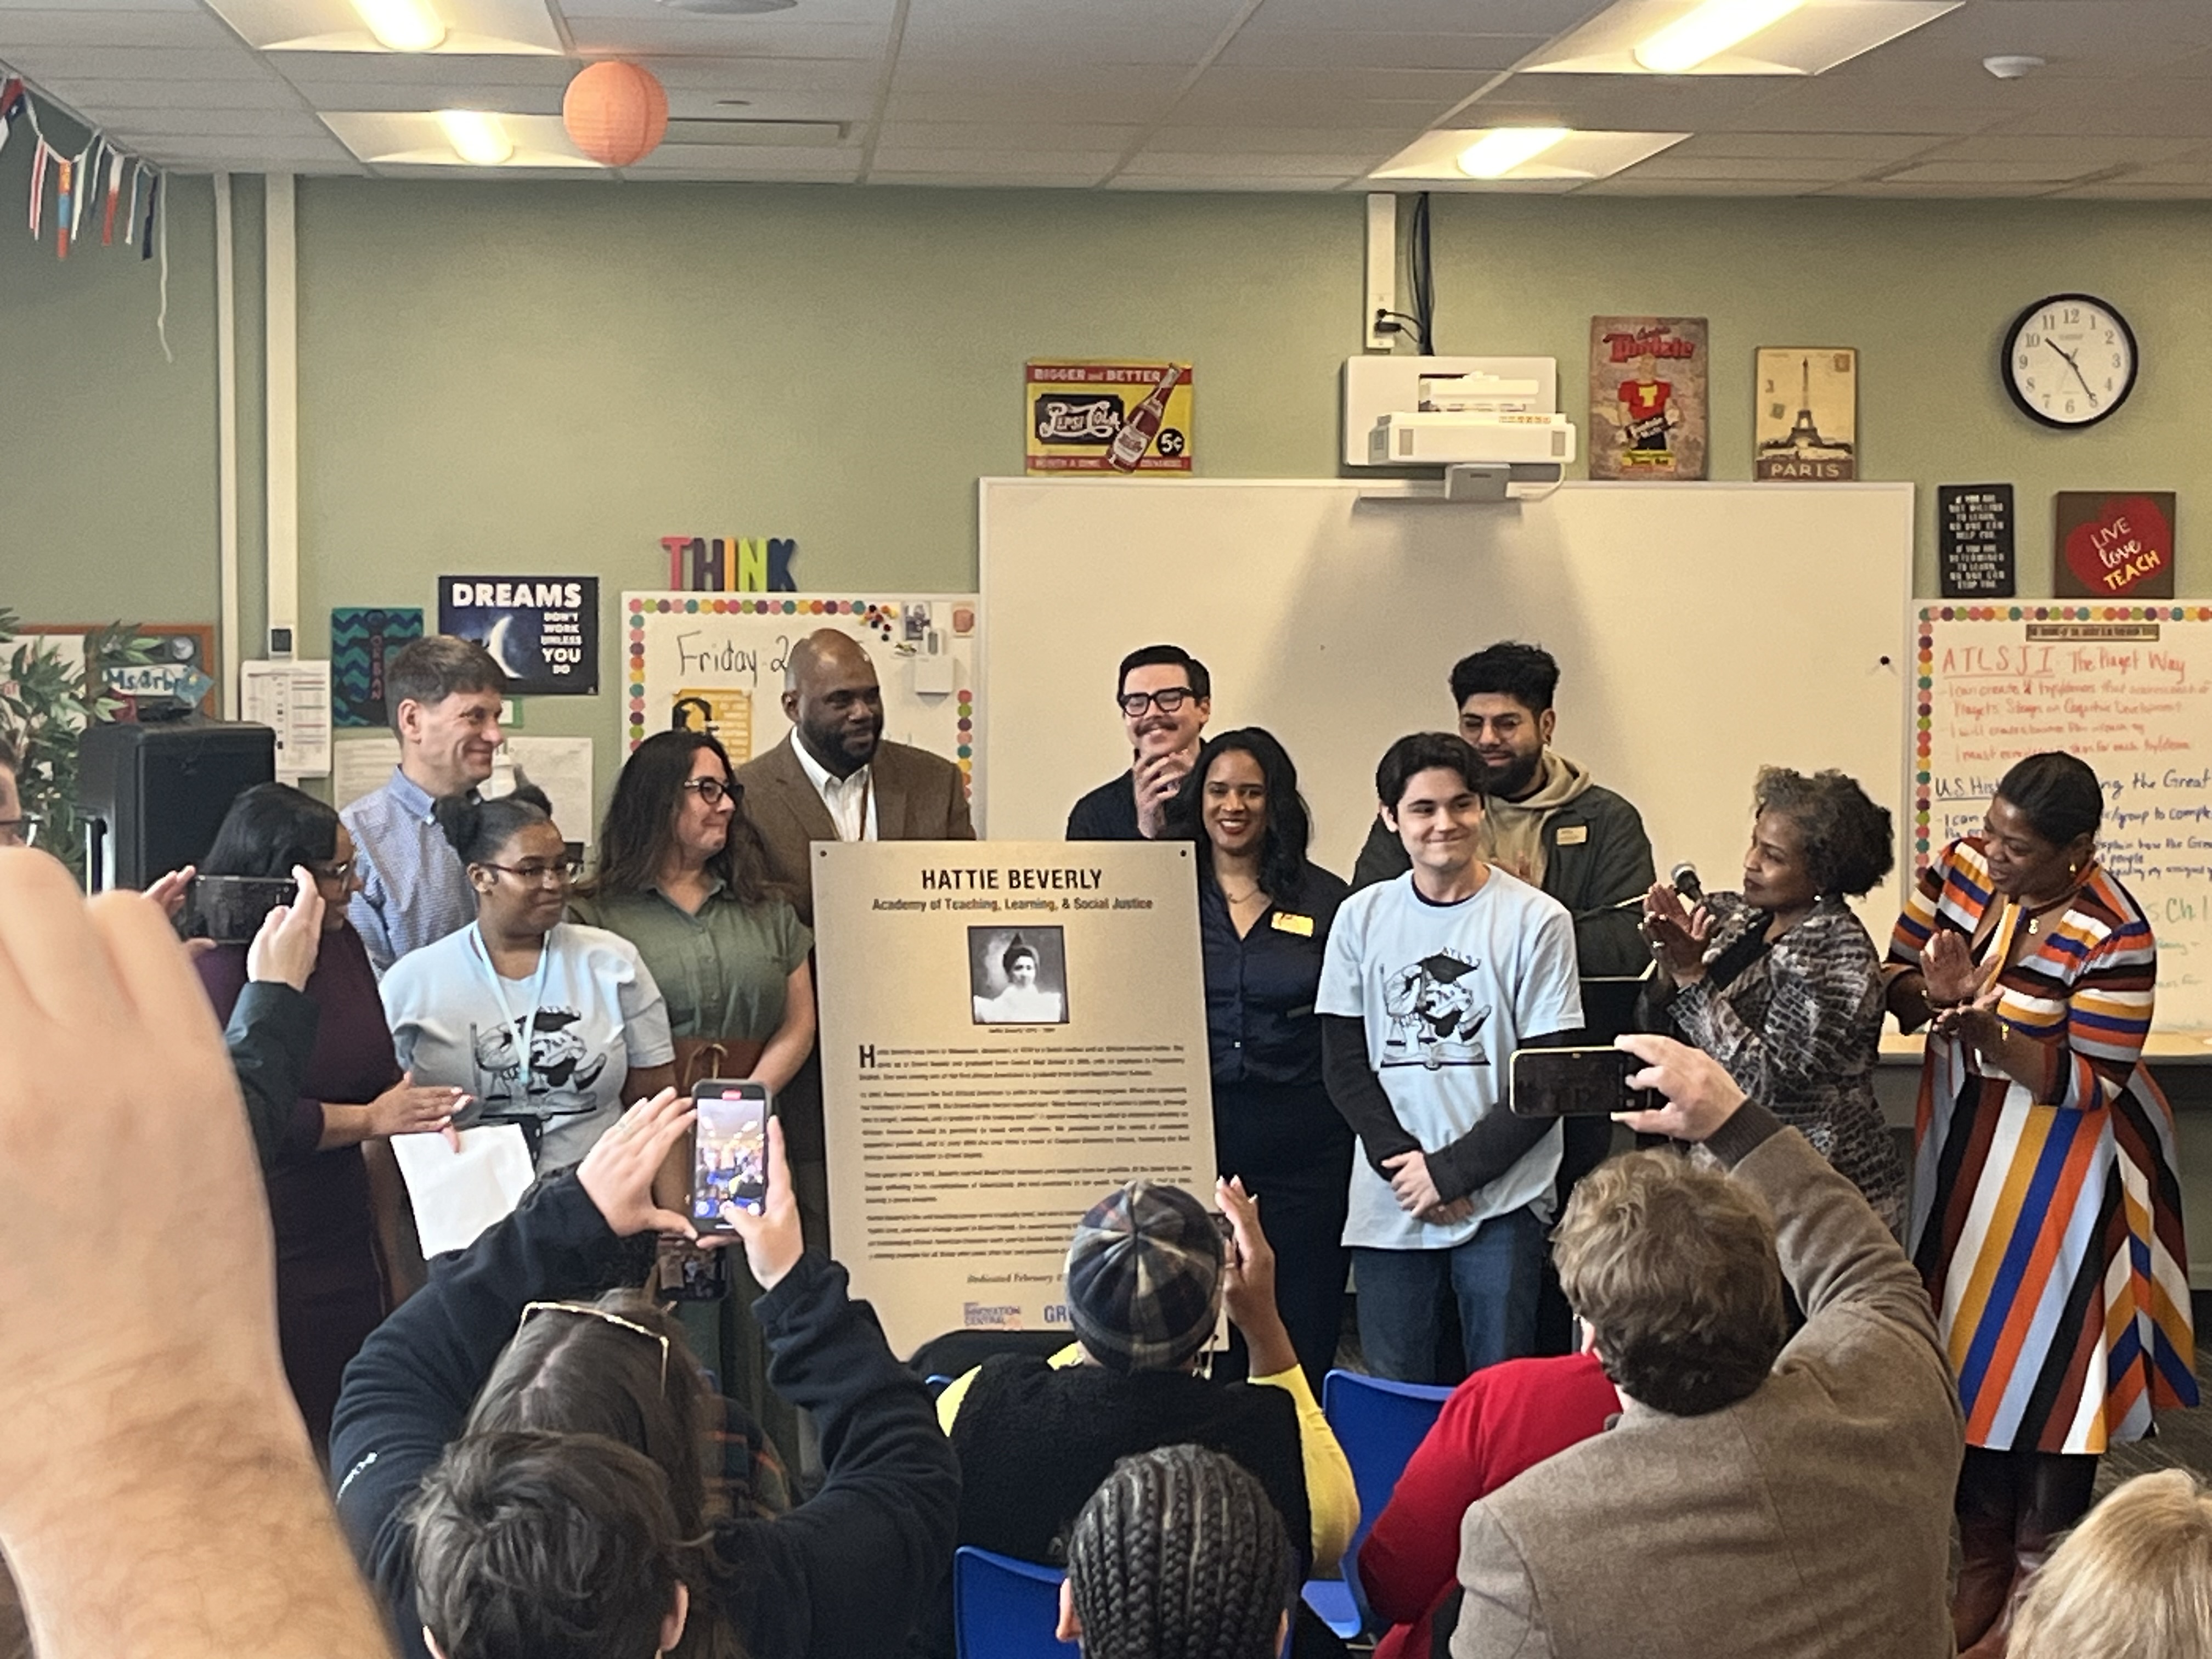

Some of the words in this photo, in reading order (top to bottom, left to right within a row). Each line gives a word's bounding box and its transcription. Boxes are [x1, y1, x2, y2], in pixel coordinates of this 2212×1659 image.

[2042, 315, 2055, 330] 11
[2063, 308, 2080, 324] 12
[2090, 314, 2096, 330] 1
[2025, 332, 2040, 348] 10
[2104, 330, 2114, 345] 2
[2019, 354, 2028, 369] 9
[2112, 352, 2121, 368] 3
[1035, 369, 1085, 381] BIGGER
[1107, 371, 1161, 383] BETTER
[2104, 377, 2112, 391] 4
[2025, 377, 2035, 392] 8
[2042, 393, 2051, 409] 7
[2065, 399, 2074, 413] 6
[2089, 393, 2098, 408] 5
[1161, 433, 1183, 453] 5¢
[1771, 463, 1839, 477] PARIS
[2090, 517, 2131, 549] LIVE
[2099, 540, 2141, 568] love
[661, 537, 797, 591] THINK
[2103, 550, 2160, 590] TEACH
[453, 583, 582, 608] DREAMS
[543, 624, 579, 633] WORK
[542, 648, 581, 663] YOU
[677, 630, 758, 687] Friday
[771, 635, 788, 672] 2
[552, 664, 570, 674] DO
[2067, 646, 2096, 674] The
[2148, 651, 2186, 685] Way
[2132, 772, 2155, 789] the
[2163, 768, 2210, 788] Great
[2155, 806, 2165, 820] to
[922, 869, 999, 890] HATTIE
[1008, 869, 1102, 890] BEVERLY
[872, 899, 926, 912] Academy
[930, 899, 941, 910] of
[944, 899, 1001, 912] Teaching,
[1005, 898, 1058, 912] Learning,
[1062, 898, 1070, 909] &
[1074, 898, 1109, 910] Social
[1112, 898, 1153, 910] Justice
